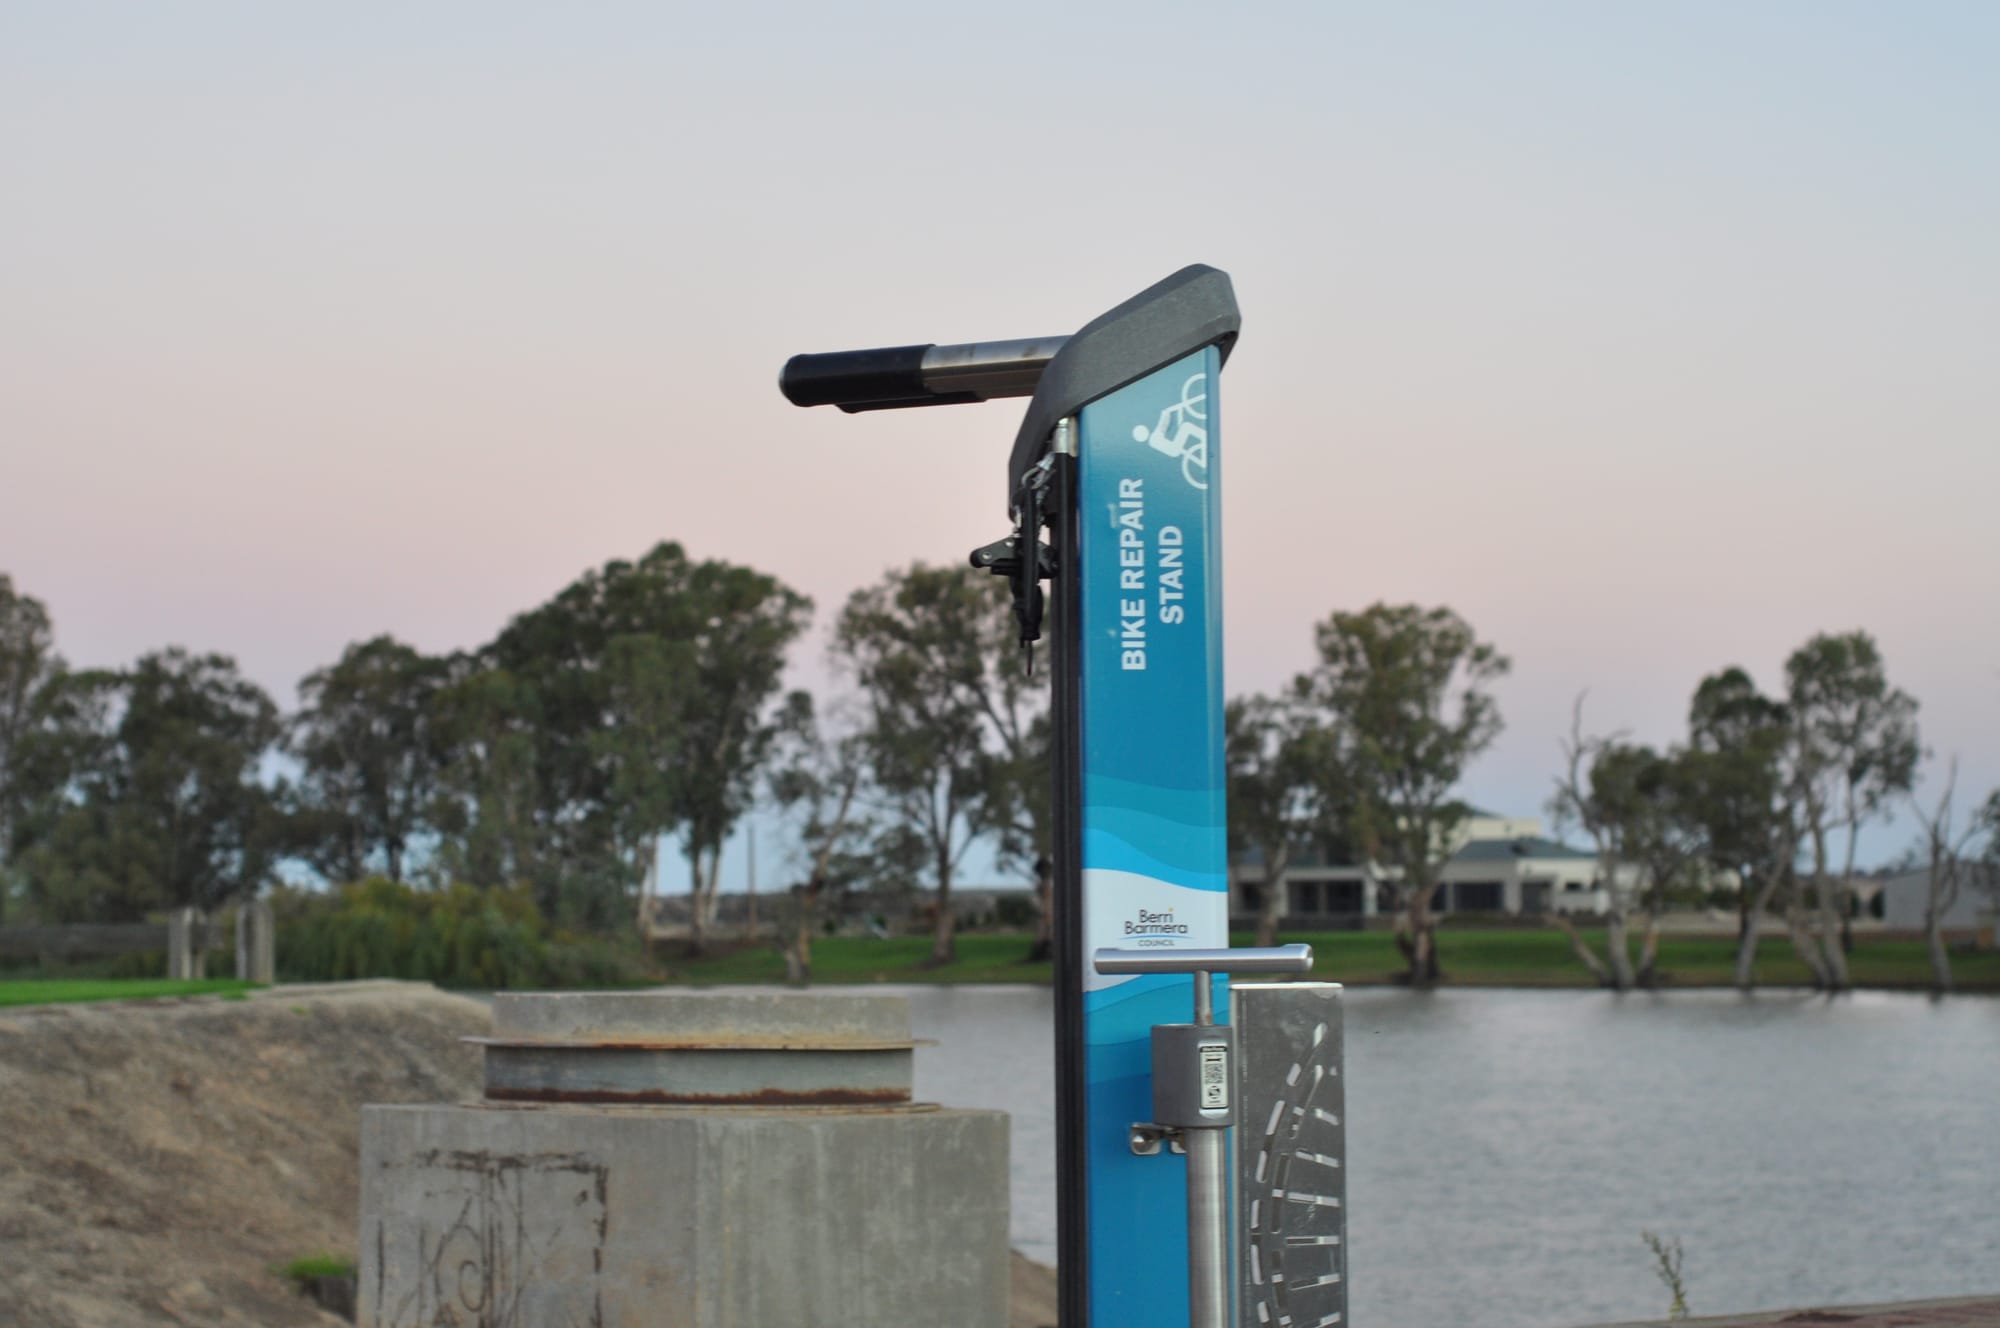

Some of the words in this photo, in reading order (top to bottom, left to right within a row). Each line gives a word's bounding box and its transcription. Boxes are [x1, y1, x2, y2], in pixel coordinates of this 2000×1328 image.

[1119, 478, 1145, 590] REPAIR
[1158, 525, 1184, 625] STAND
[1120, 599, 1146, 670] BIKE
[1124, 921, 1188, 934] Barmera
[1139, 907, 1174, 923] Berri
